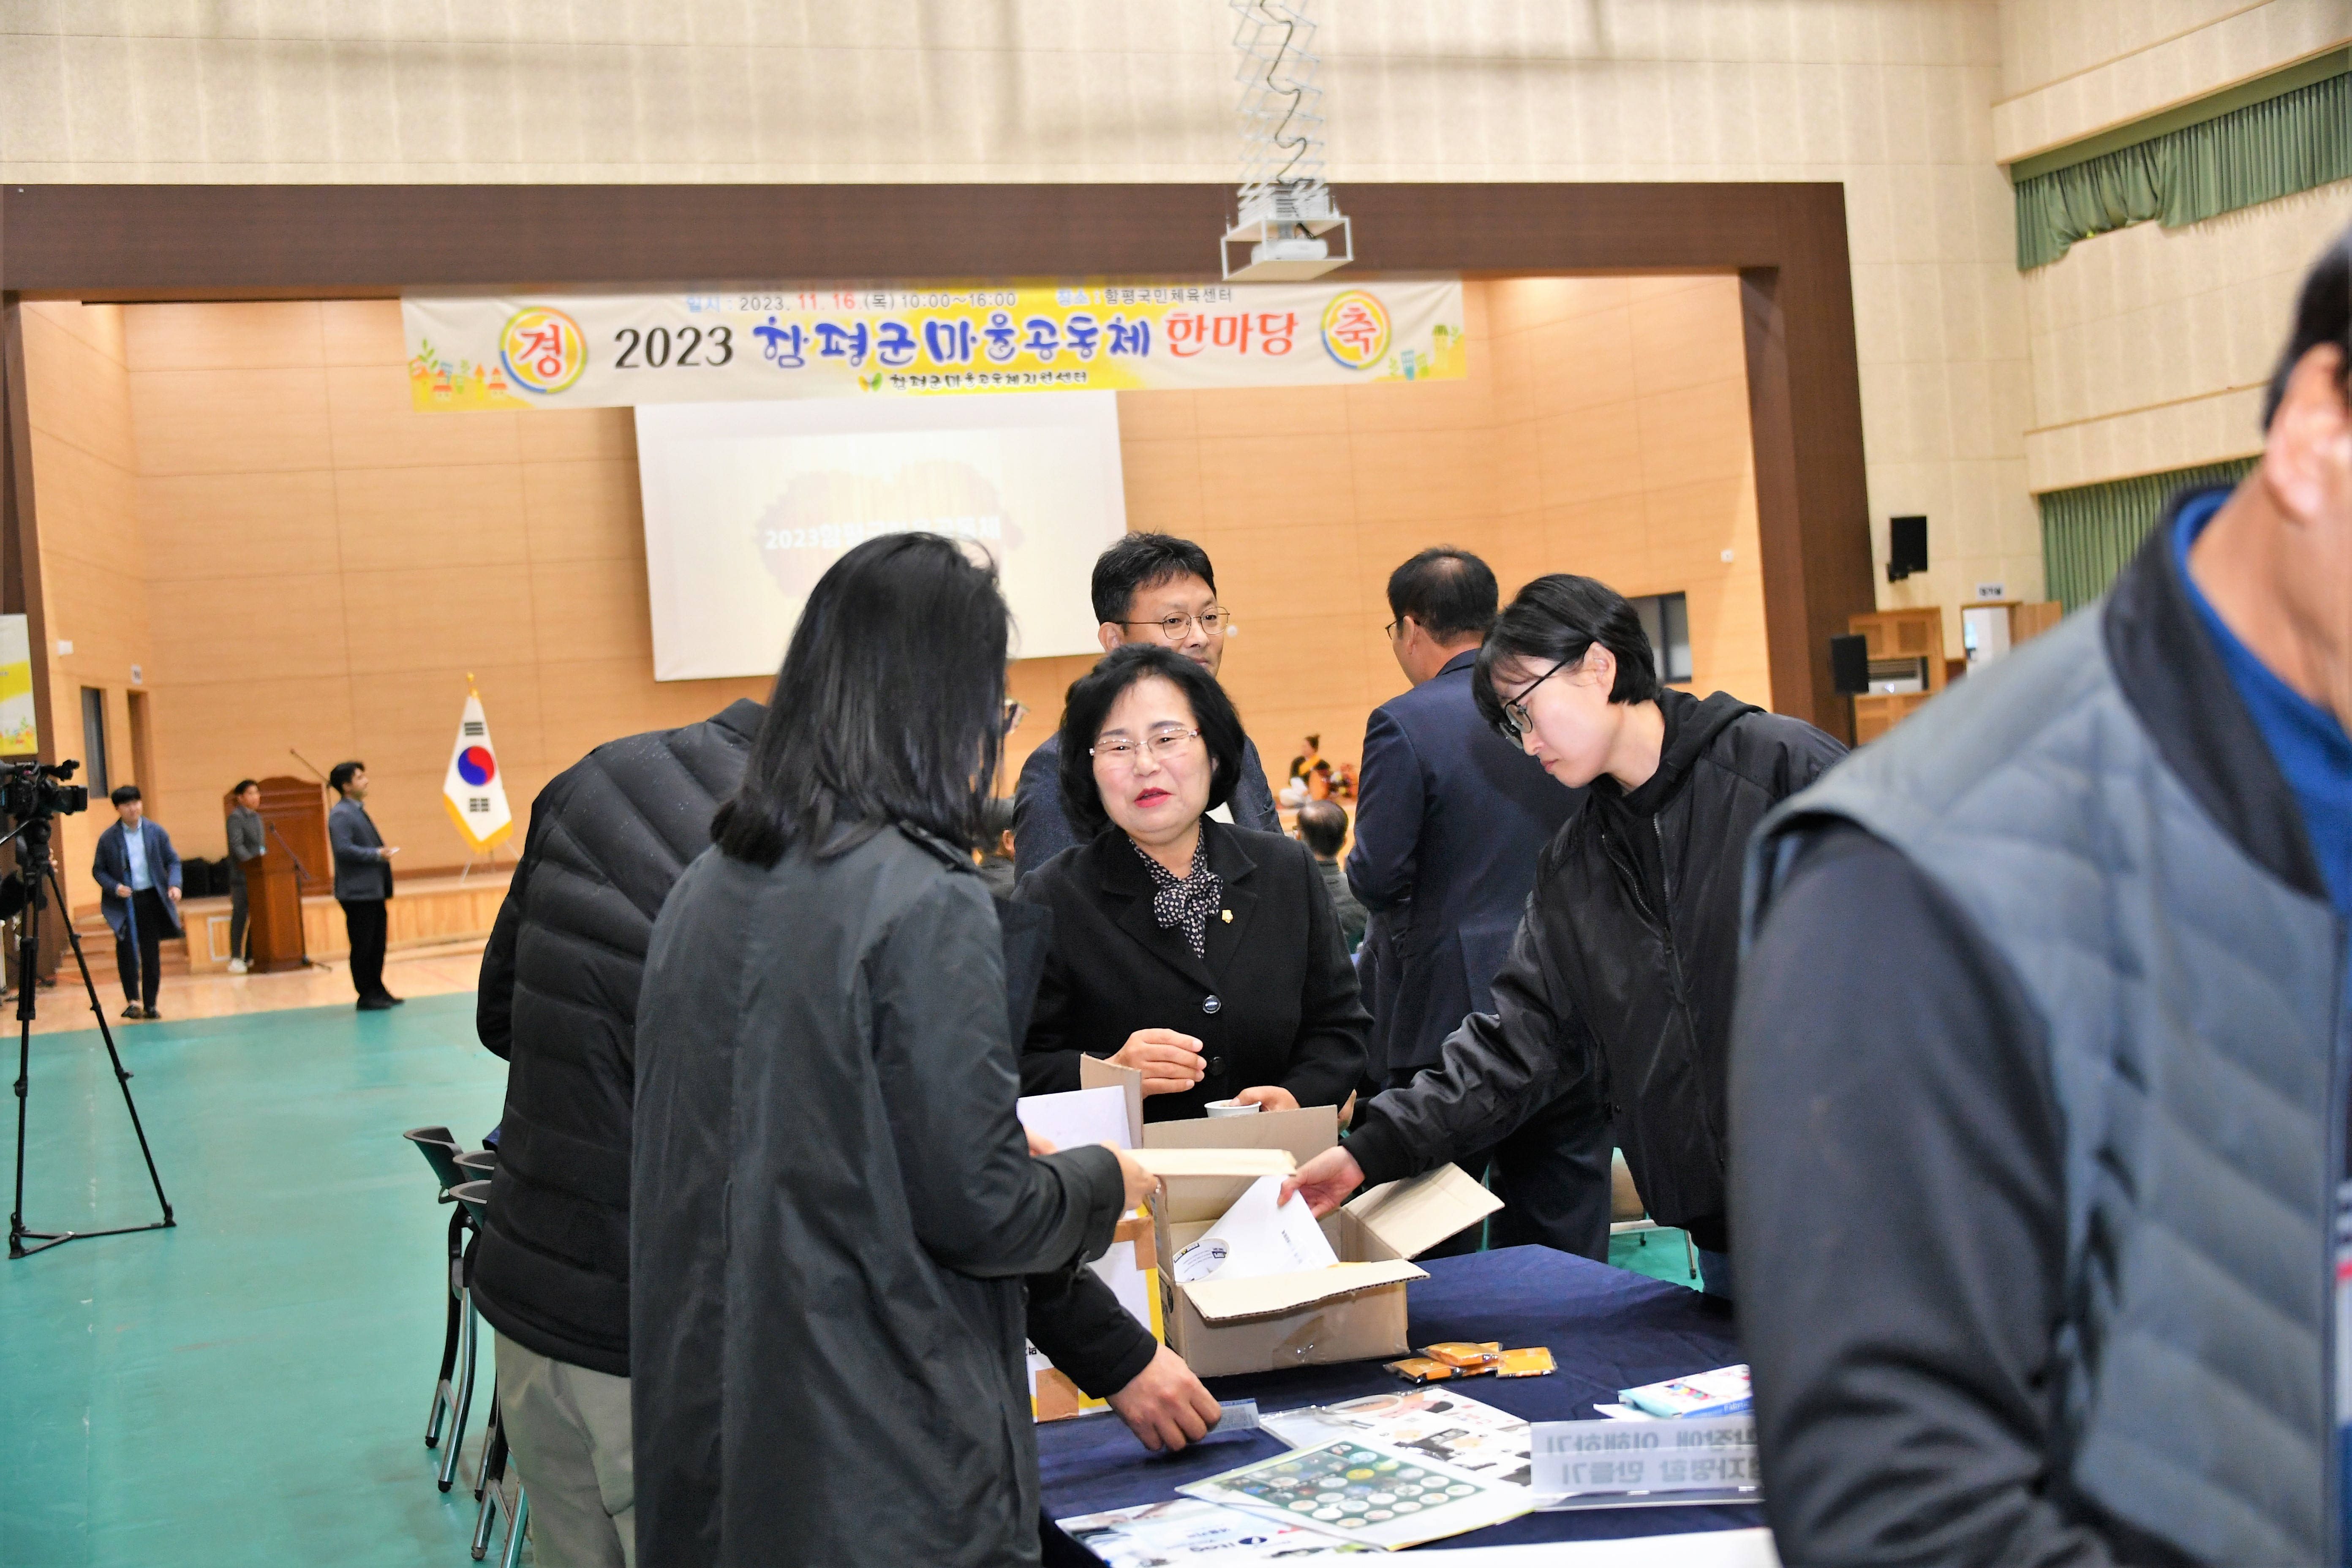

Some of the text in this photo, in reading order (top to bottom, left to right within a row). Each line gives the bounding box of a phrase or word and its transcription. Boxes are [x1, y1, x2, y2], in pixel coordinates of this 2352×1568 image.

[686, 297, 720, 313] 일시
[740, 297, 790, 311] 2023.
[1057, 289, 1088, 306] 장소
[1105, 288, 1233, 305] 함평국민체육센터
[519, 324, 562, 378] 경
[614, 312, 1299, 370] 2023 함평군마을공동체 한마당
[1334, 307, 1377, 355] 축
